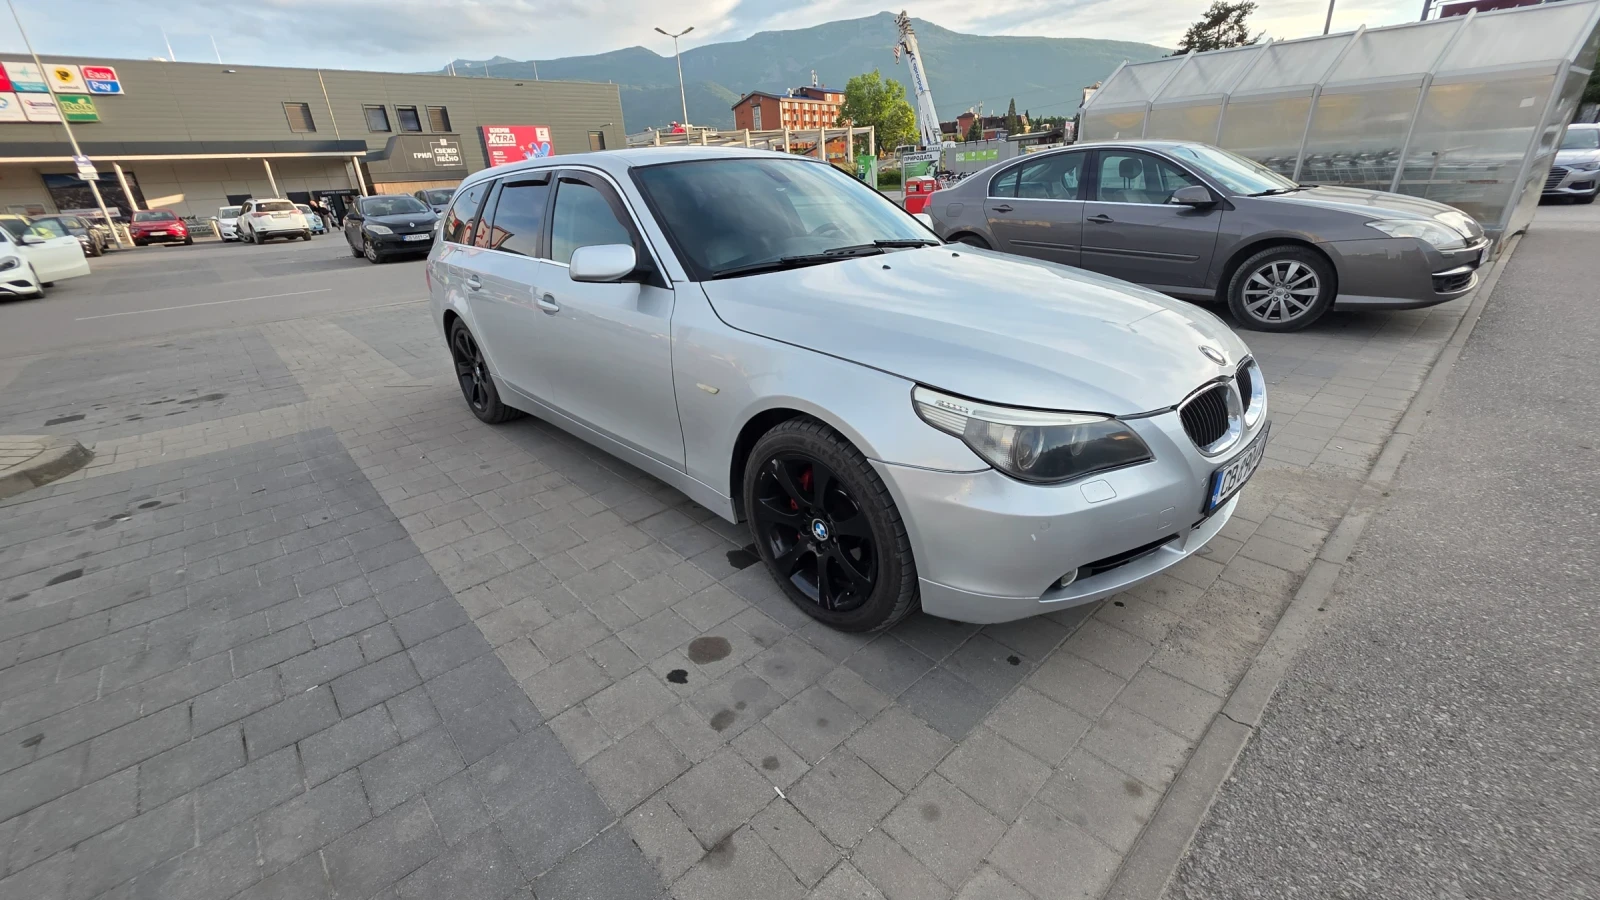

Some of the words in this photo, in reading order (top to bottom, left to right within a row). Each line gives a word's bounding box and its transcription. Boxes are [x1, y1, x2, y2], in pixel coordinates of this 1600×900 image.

[87, 69, 112, 80] Easy
[91, 81, 111, 91] Pay
[488, 133, 516, 144] XTRA
[904, 153, 933, 161] ПРИРОДАТА
